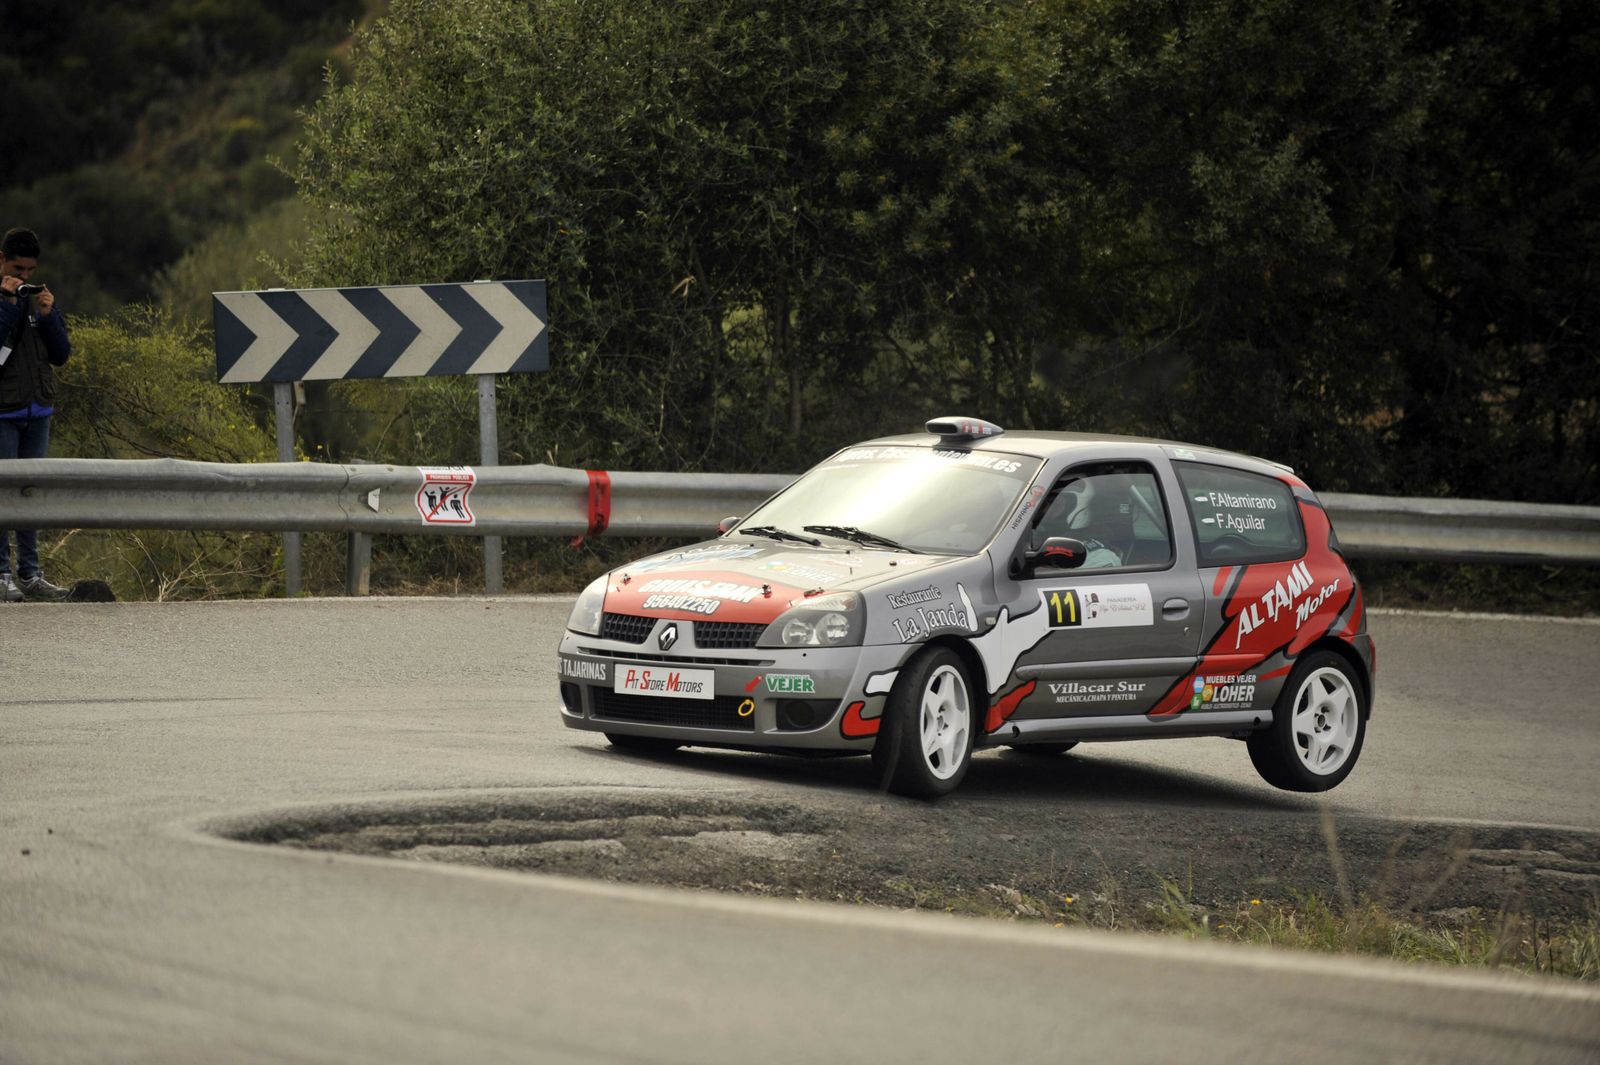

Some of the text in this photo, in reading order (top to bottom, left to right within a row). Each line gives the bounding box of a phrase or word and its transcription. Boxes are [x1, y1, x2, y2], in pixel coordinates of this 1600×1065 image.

[1209, 492, 1277, 509] F.Altamirano
[1216, 513, 1265, 533] F.Aguilar
[642, 594, 721, 615] 956402250
[886, 584, 941, 609] Restaurante
[1295, 578, 1340, 630] Motor
[1050, 592, 1077, 623] 11
[893, 603, 969, 643] La Janda
[562, 658, 606, 681] TAJARINAS
[1206, 674, 1257, 684] MUEBLES VEJER
[766, 678, 814, 692] VEJER
[1048, 681, 1147, 694] Villacar Sur
[1212, 685, 1255, 702] LOHER
